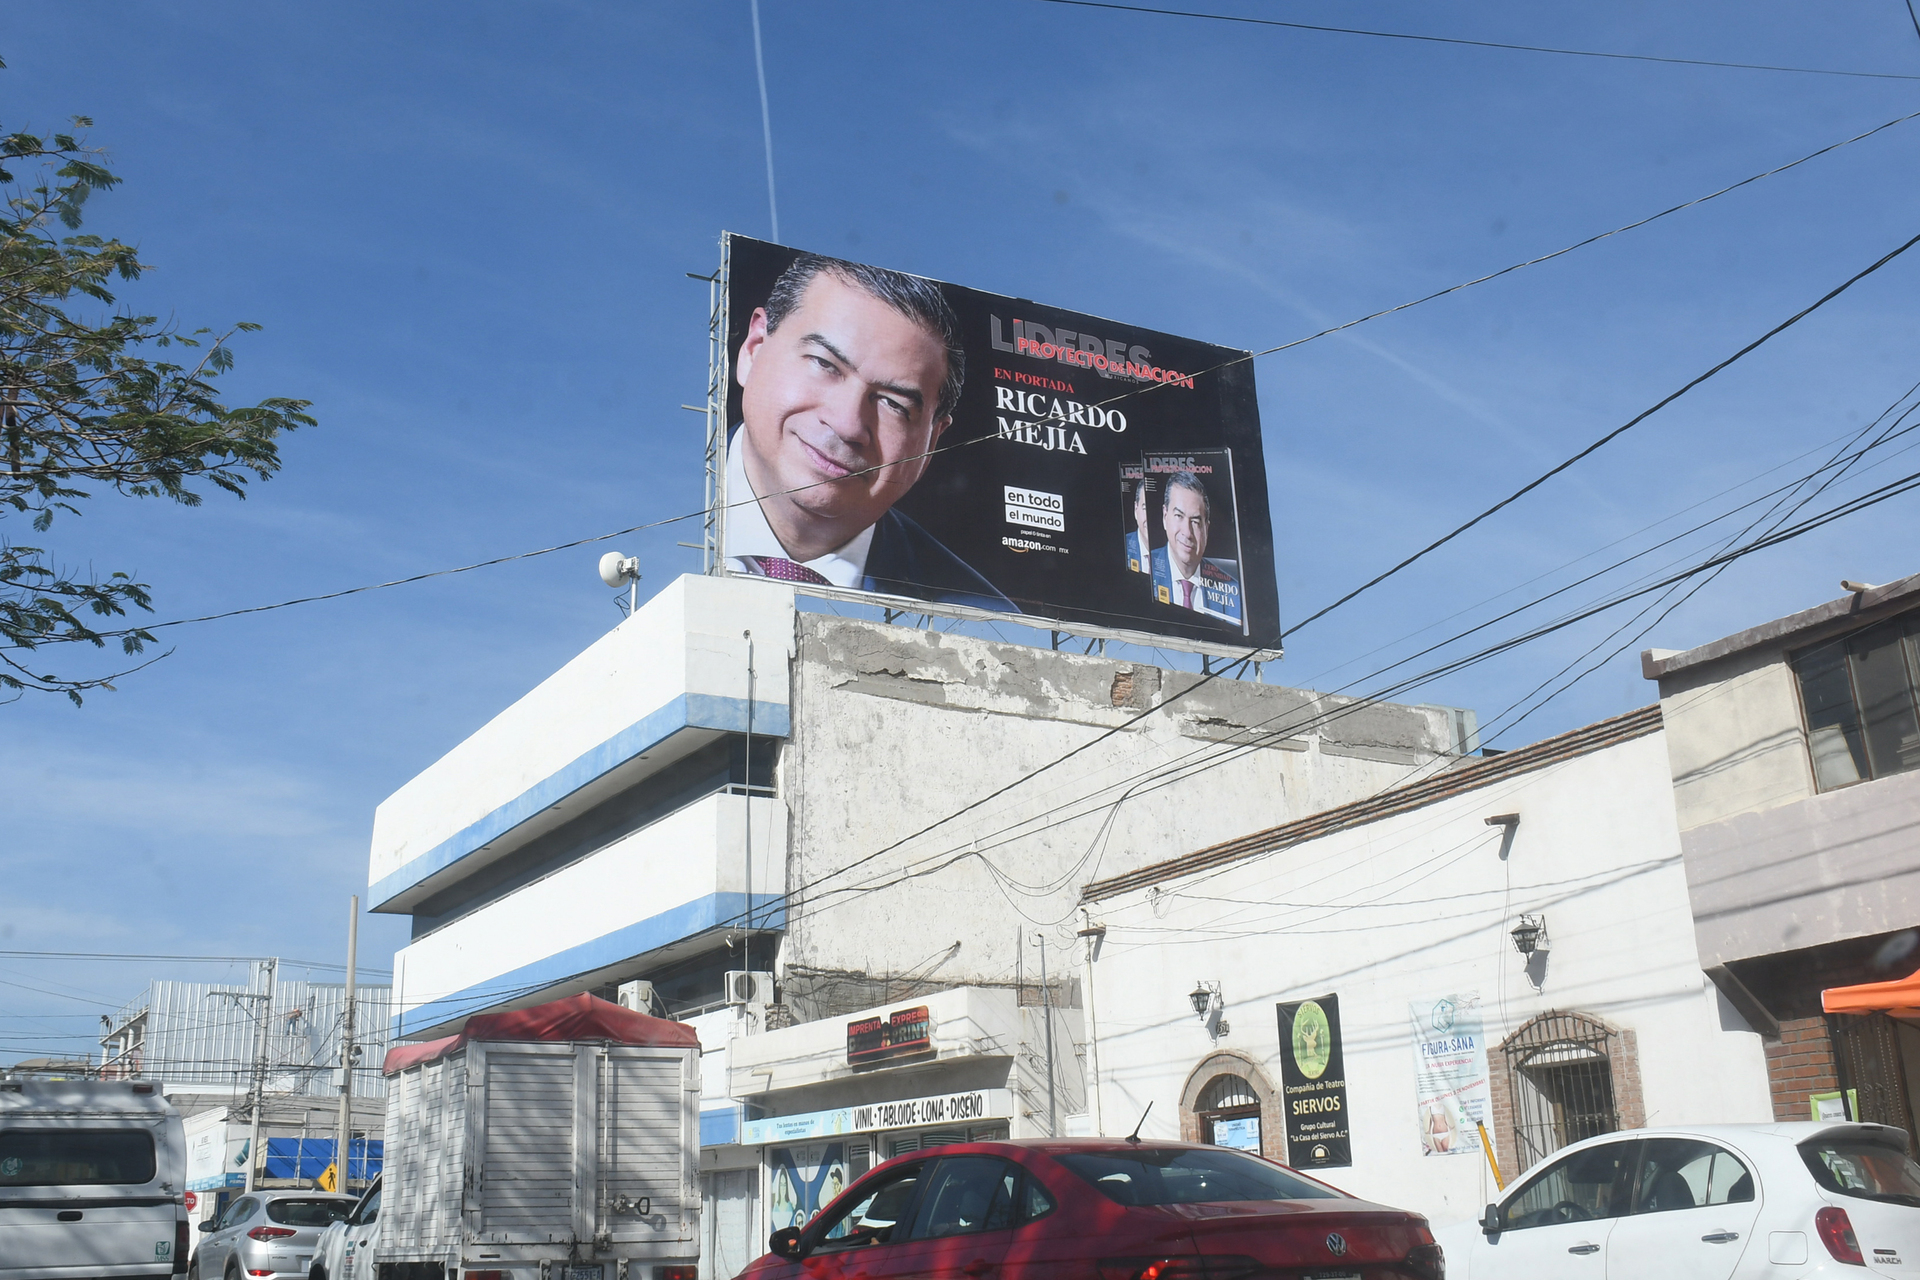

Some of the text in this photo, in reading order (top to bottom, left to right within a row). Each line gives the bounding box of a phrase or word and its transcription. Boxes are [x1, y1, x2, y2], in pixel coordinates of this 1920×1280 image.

[1018, 337, 1194, 389] PROYECTO DE NACION
[994, 367, 1075, 394] EN PORTADA
[995, 385, 1127, 433] RICARDO
[996, 416, 1088, 455] MEJÍA
[1008, 492, 1061, 509] en todo
[1009, 510, 1062, 527] el mundo
[1002, 536, 1056, 552] amazon.com
[1198, 577, 1239, 596] RICARDO
[1207, 590, 1235, 608] MEJÍA
[891, 1010, 929, 1027] EXPRESS
[848, 1019, 882, 1037] IMPRENTA
[1316, 1081, 1324, 1090] de
[1324, 1079, 1345, 1089] Teatro
[853, 1092, 983, 1130] VINIL TABLOIDE LONA DISEÑO
[1292, 1095, 1341, 1116] SIERVOS
[783, 1121, 793, 1129] lentes
[1300, 1120, 1336, 1131] Grupo Cultural
[1311, 1132, 1319, 1140] del
[1320, 1131, 1335, 1140] Siervo
[1873, 1256, 1902, 1265] MARCH
